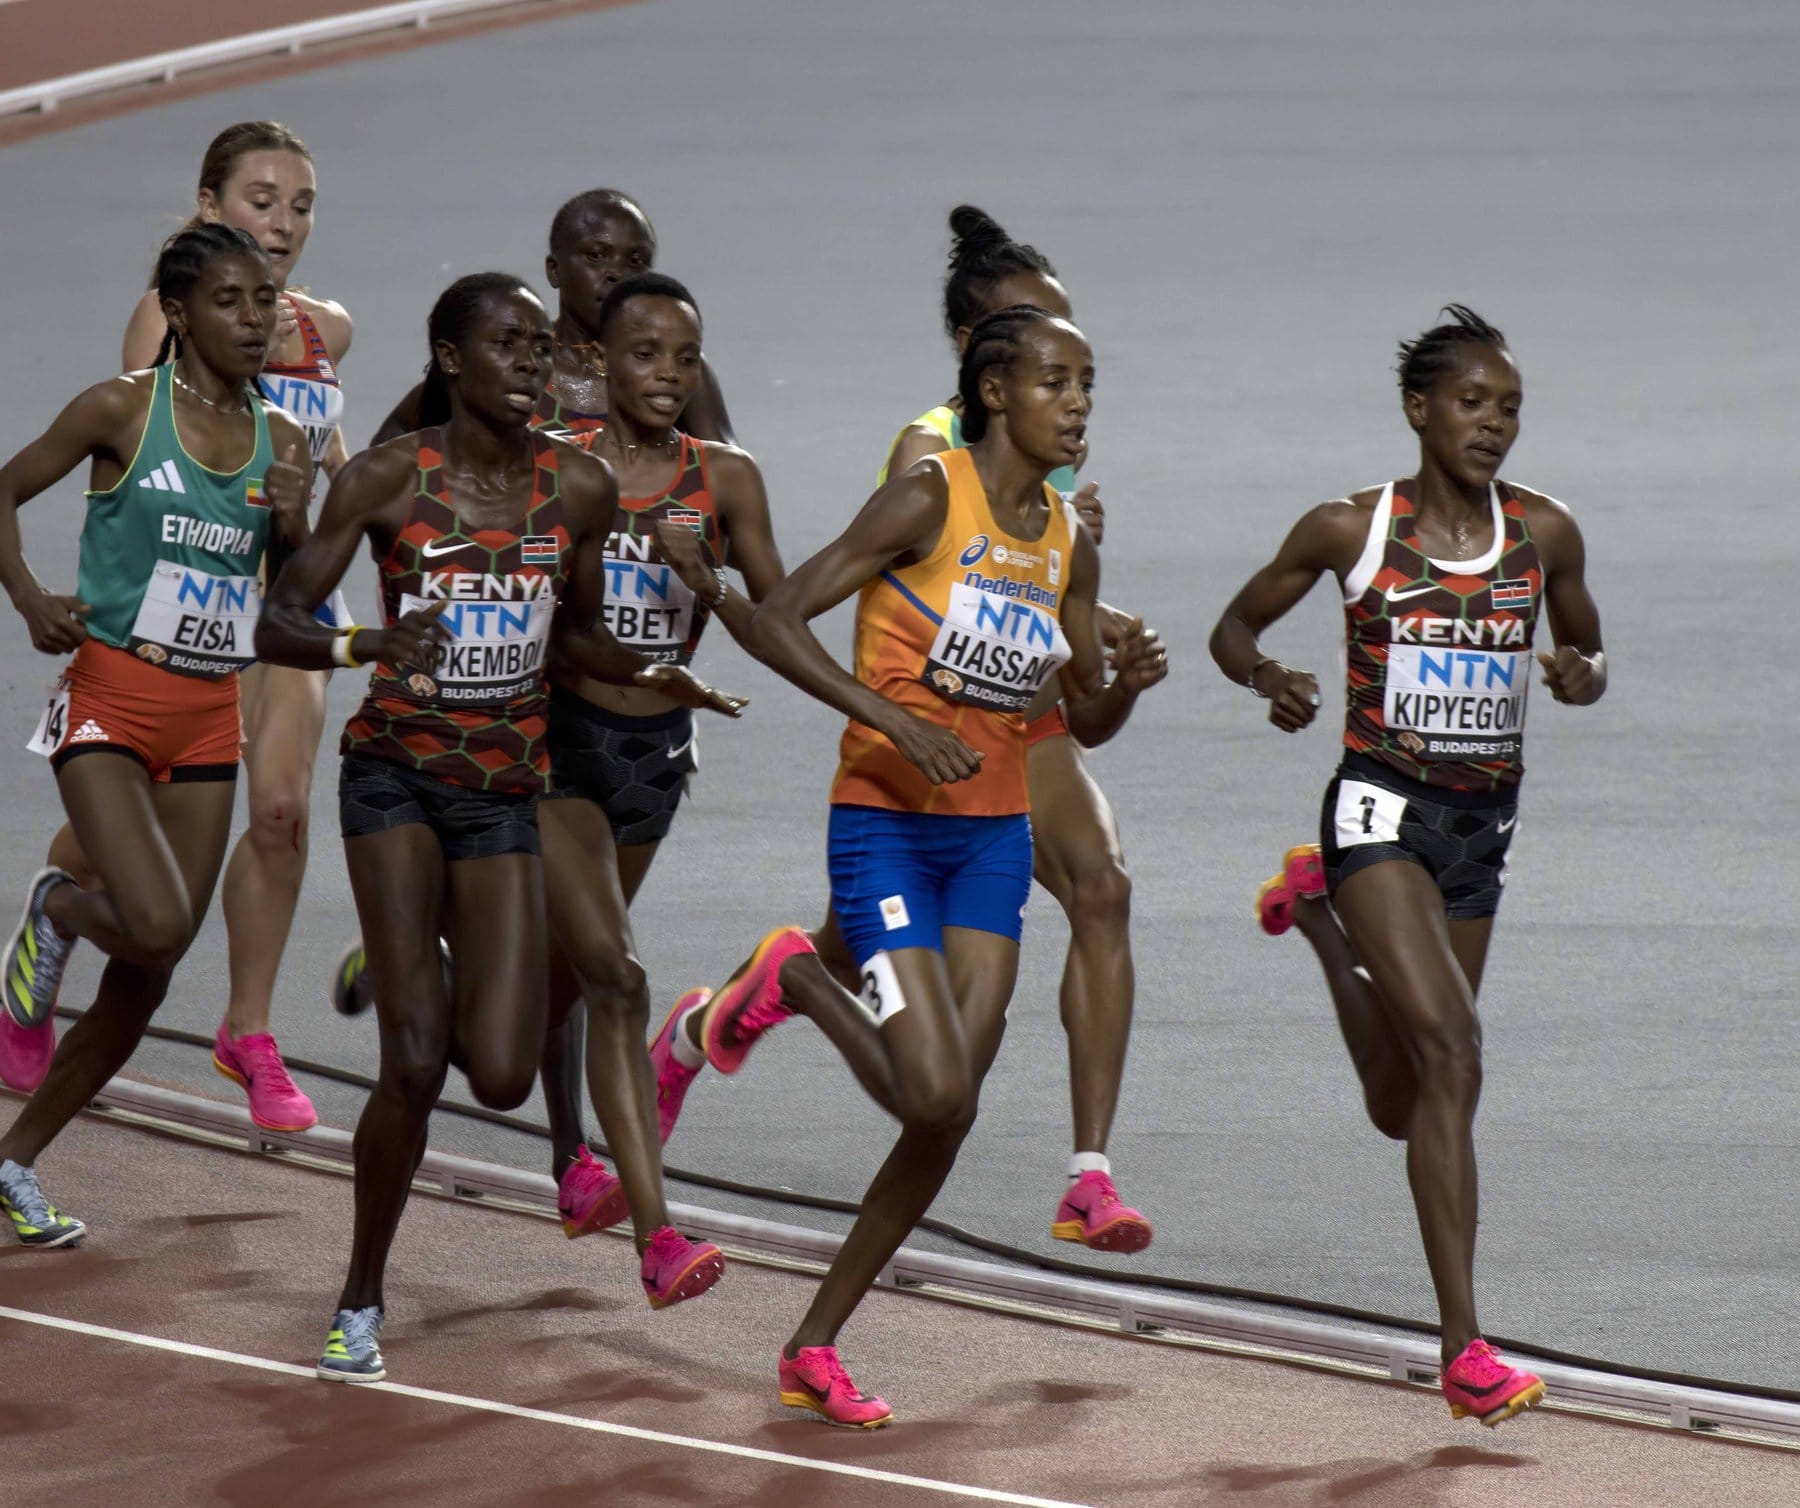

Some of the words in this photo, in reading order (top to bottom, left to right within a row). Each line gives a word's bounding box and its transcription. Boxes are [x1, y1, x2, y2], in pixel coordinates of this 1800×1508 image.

[162, 514, 254, 555] ETHIOPIA
[177, 570, 249, 614] NTN
[421, 571, 554, 601] KENYA
[604, 560, 670, 601] TN
[173, 614, 236, 652] EISA
[438, 603, 531, 639] NTN
[975, 595, 1053, 652] NTN
[1390, 616, 1526, 646] KENYA
[940, 630, 1056, 687] HASSAN
[1418, 650, 1516, 691] NTN
[42, 698, 66, 749] 14
[1393, 691, 1521, 731] KIPYEGON
[1359, 795, 1377, 834] 1
[864, 970, 882, 1014] 3
